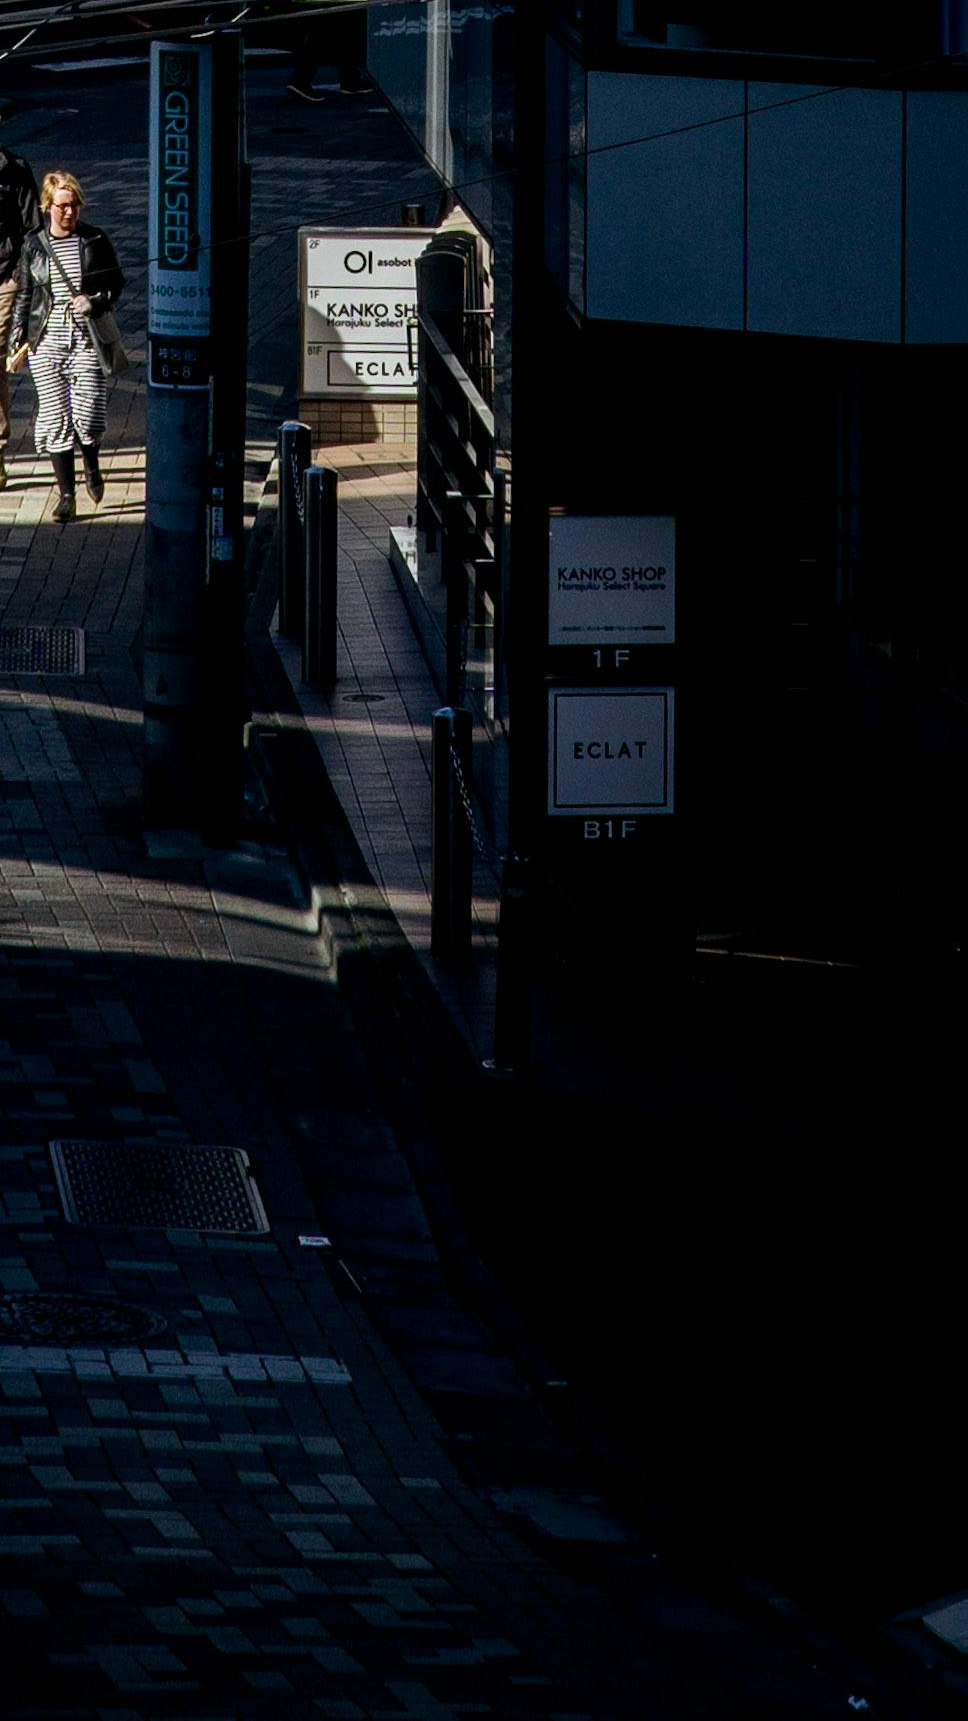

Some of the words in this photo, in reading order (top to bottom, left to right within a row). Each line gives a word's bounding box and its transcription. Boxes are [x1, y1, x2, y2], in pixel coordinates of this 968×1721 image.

[163, 90, 191, 186] GREEN
[163, 191, 191, 265] SEED
[308, 239, 320, 250] 2F
[376, 257, 412, 267] asobot
[308, 289, 320, 300] 1F
[327, 303, 388, 318] KANKO
[394, 303, 419, 318] SH
[326, 318, 371, 329] Harajuku
[374, 317, 403, 328] Select
[557, 566, 616, 582] KANKO
[621, 566, 667, 582] SHOP
[557, 582, 600, 593] Harajuku
[602, 581, 631, 591] Select
[633, 581, 666, 592] Square
[572, 741, 647, 760] ECLAT
[582, 820, 638, 840] B1F
